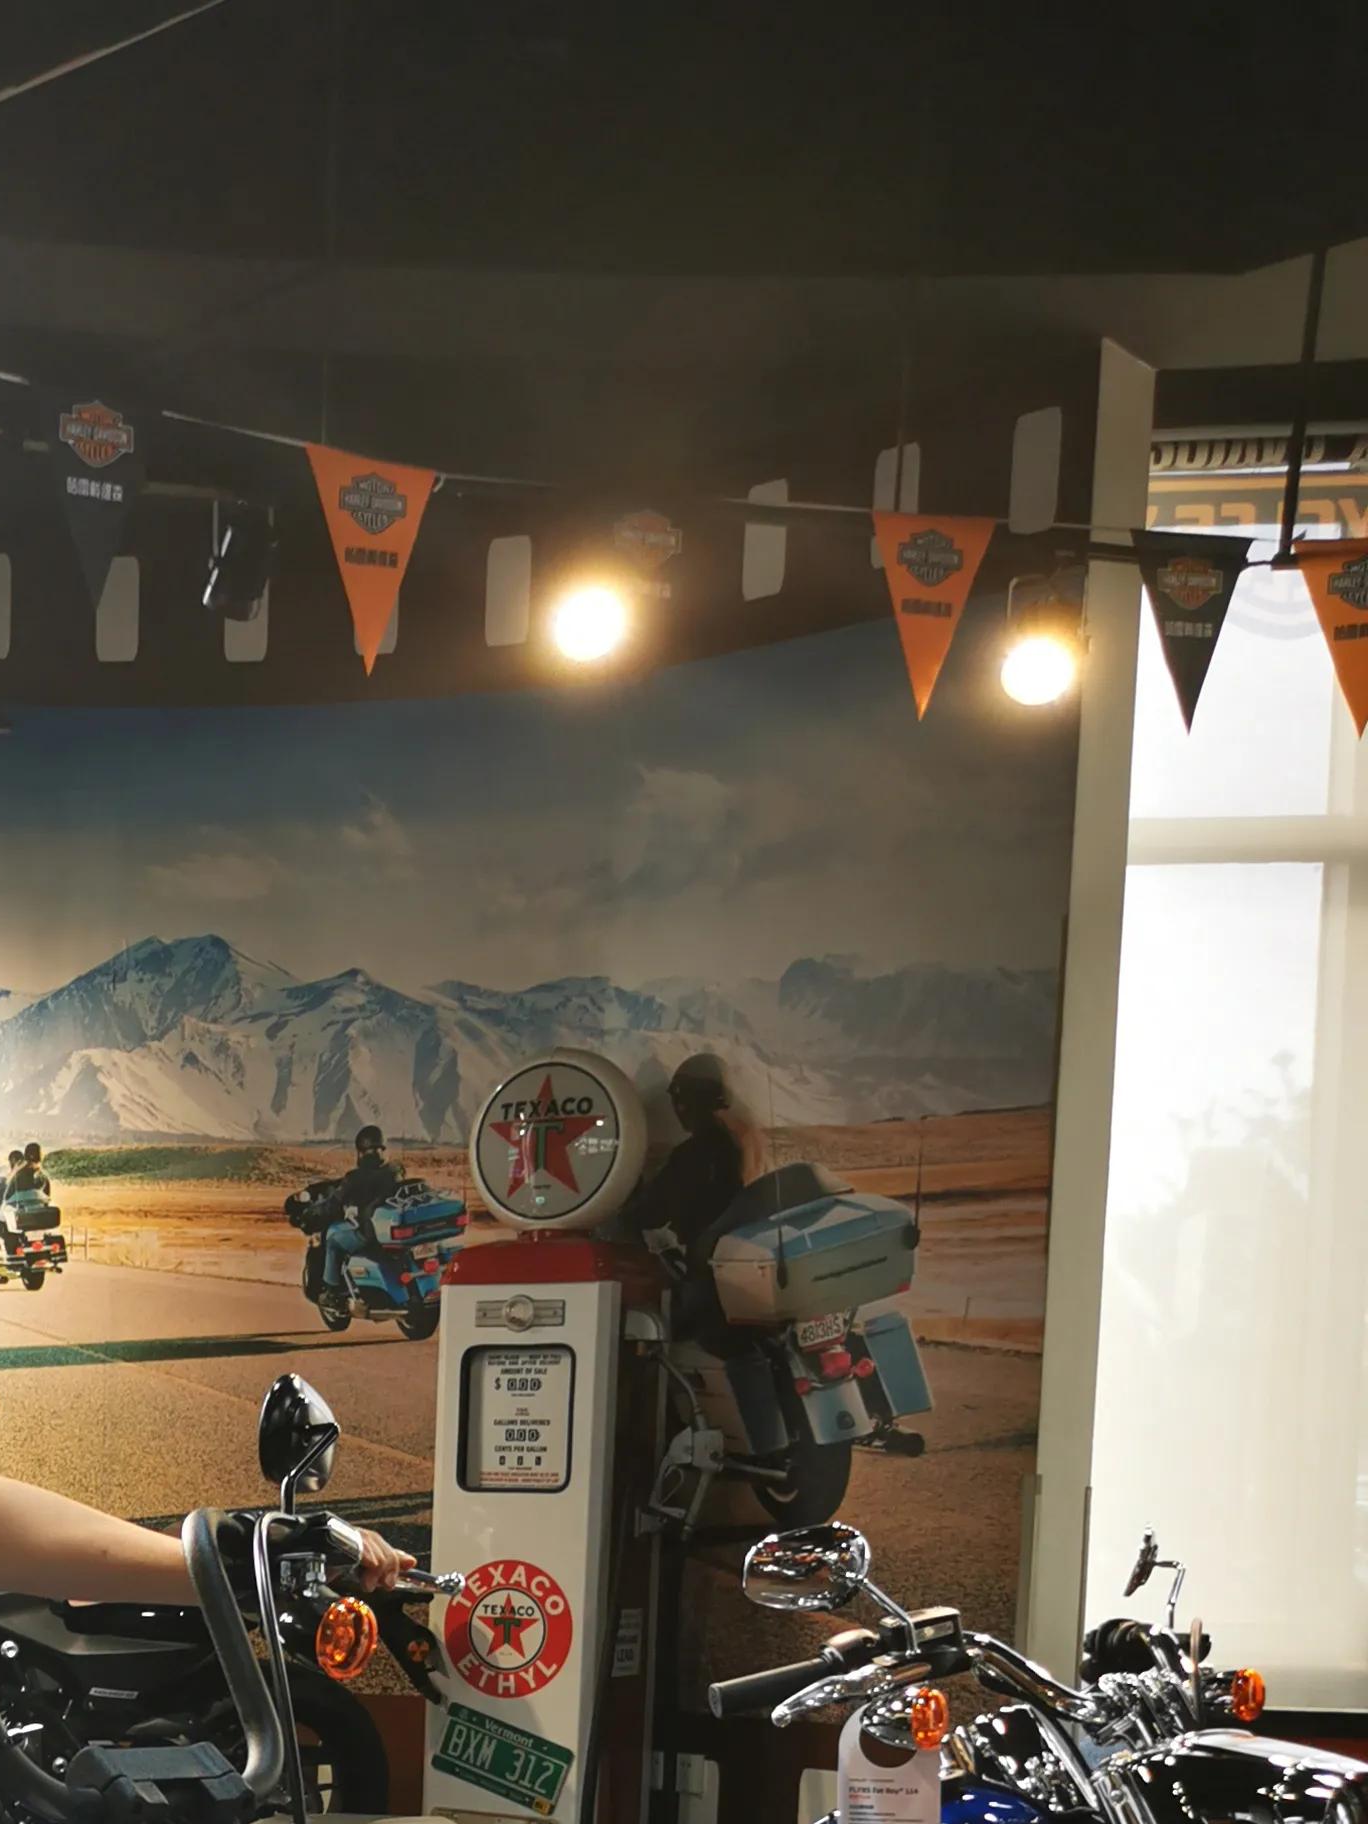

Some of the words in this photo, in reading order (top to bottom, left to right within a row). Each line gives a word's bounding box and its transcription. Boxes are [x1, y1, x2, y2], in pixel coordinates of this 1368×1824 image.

[501, 1097, 593, 1121] TEXACO
[452, 1564, 564, 1617] TEXACO
[482, 1604, 534, 1617] TEXACO
[457, 1652, 557, 1695] ETHYL
[485, 1718, 534, 1748] Vermont
[447, 1724, 497, 1770] BXM
[505, 1748, 554, 1794] 312
